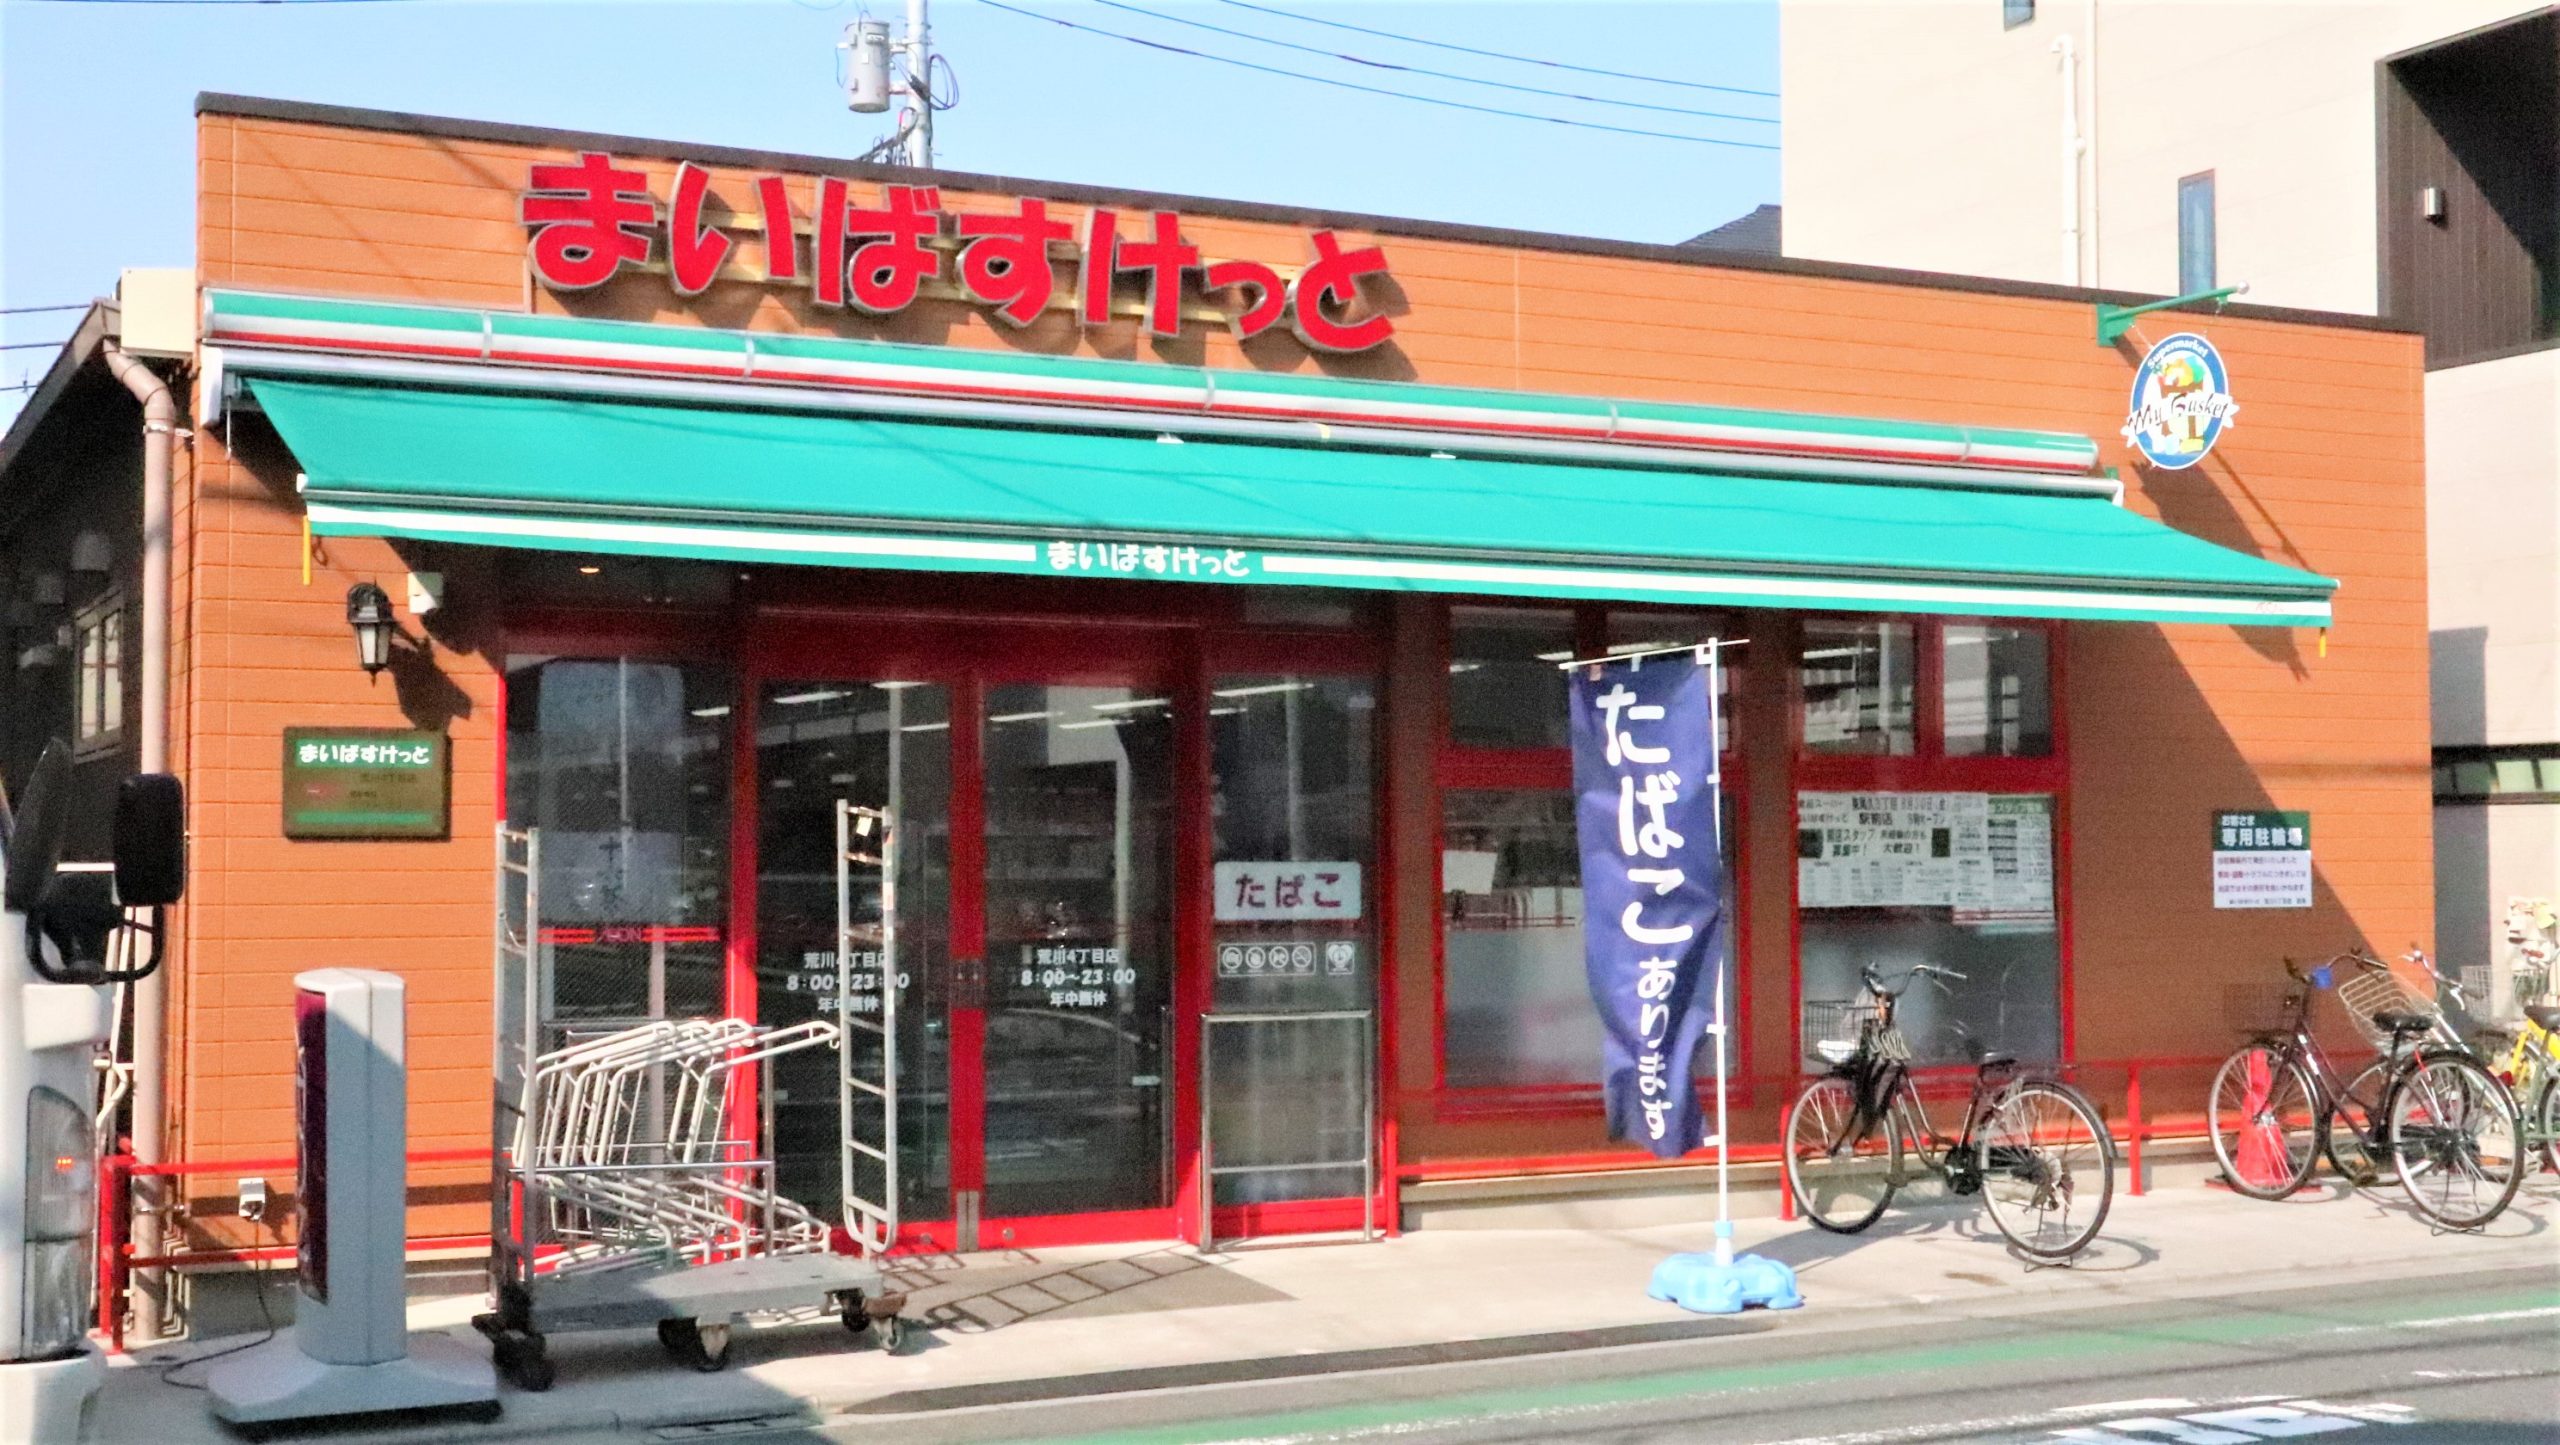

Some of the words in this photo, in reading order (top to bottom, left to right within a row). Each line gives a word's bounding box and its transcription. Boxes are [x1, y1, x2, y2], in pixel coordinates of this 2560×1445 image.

[520, 151, 1395, 354] まいばすけっと
[2147, 339, 2209, 369] Supermarket
[2128, 404, 2163, 433] My
[1047, 541, 1250, 577] まいばすけっと
[299, 743, 430, 765] まいばすけっと
[2222, 827, 2303, 847] 専用駐輪場
[1235, 873, 1342, 909] たばこ
[1037, 949, 1121, 965] 荒川4丁目店
[1050, 990, 1108, 1007] 年中無休
